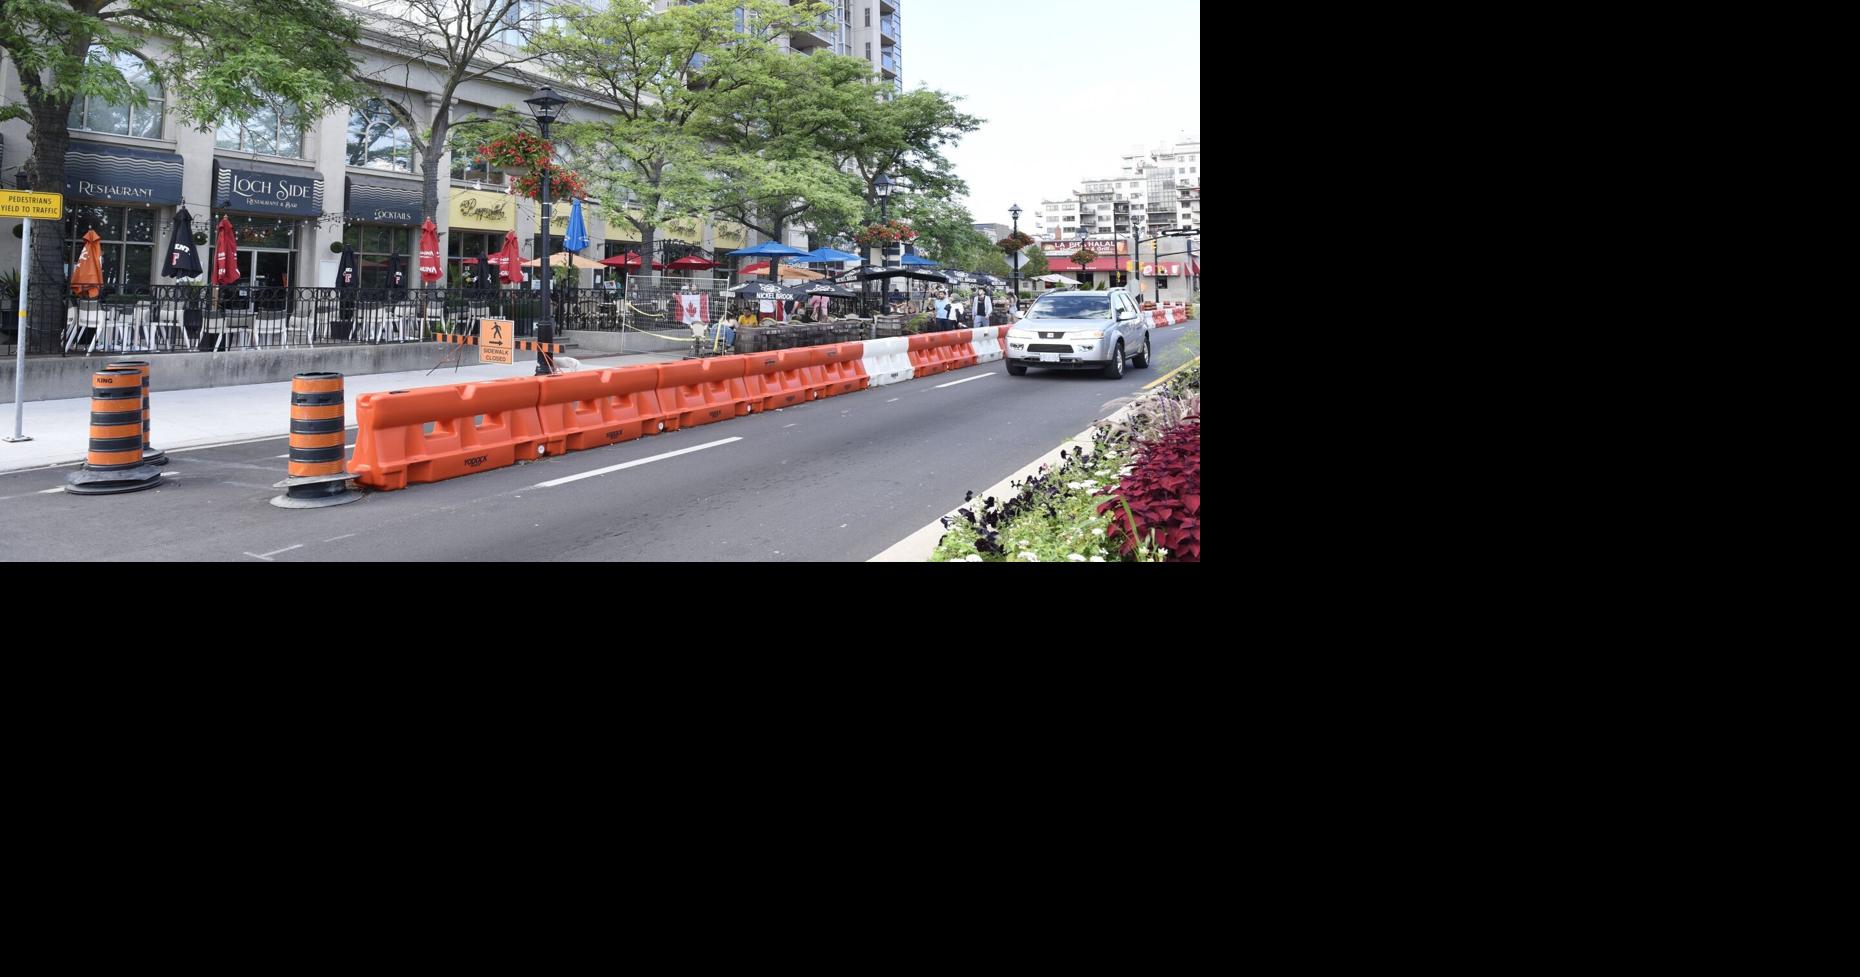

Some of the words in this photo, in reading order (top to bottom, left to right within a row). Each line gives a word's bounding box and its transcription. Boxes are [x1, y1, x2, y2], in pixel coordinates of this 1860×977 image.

[79, 181, 154, 197] RESTAURANT
[232, 175, 272, 197] LOCH
[276, 180, 311, 201] SIDE
[8, 195, 52, 205] PEDESTRIANS
[1, 204, 20, 212] YIELD
[22, 205, 31, 213] TO
[32, 206, 58, 214] TRAFFIC
[756, 291, 775, 300] NICKEL
[776, 292, 794, 300] BROOK
